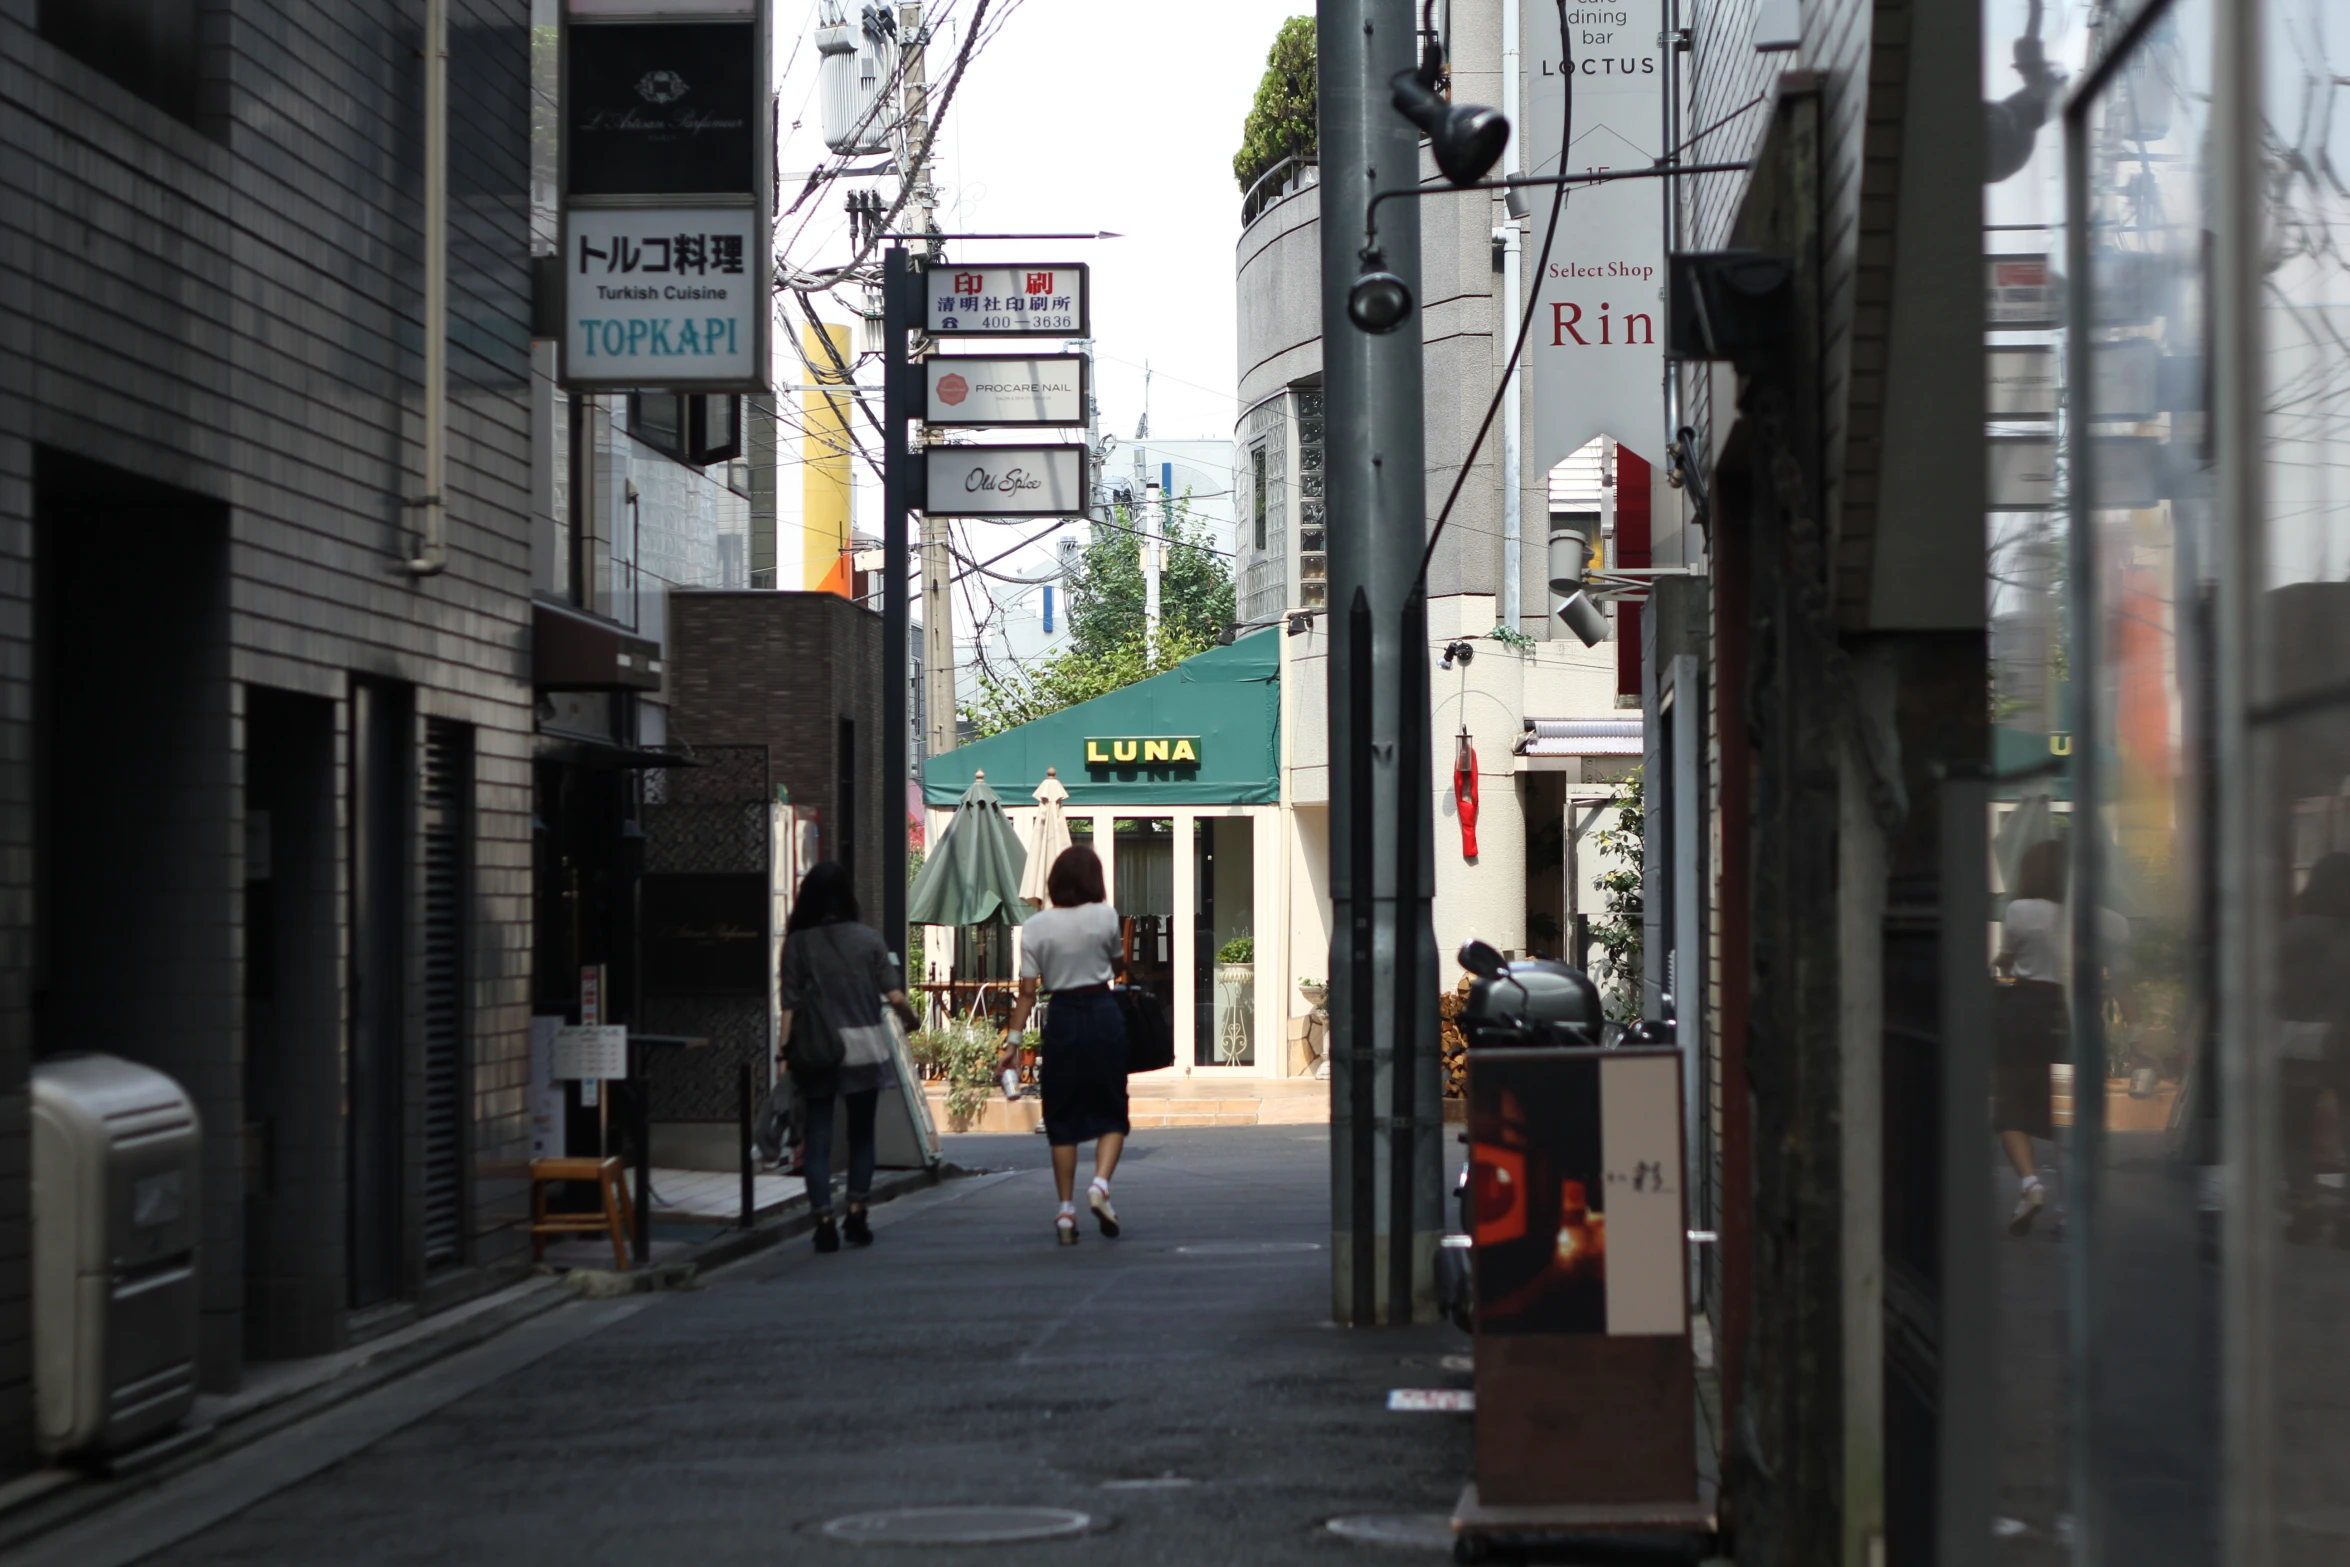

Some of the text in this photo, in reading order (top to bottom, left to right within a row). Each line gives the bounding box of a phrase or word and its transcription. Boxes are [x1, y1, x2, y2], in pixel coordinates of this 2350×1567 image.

[1568, 9, 1627, 26] dining
[1582, 30, 1614, 45] bar
[1542, 57, 1654, 76] LOCTUS
[579, 233, 745, 276] トルコ料理
[1549, 260, 1654, 281] Select Shop
[596, 285, 728, 300] Turkish Cuisine
[937, 296, 1072, 313] 清明社印刷所
[1548, 302, 1656, 347] Rin
[578, 317, 739, 357] TOPKAPI
[975, 384, 1039, 393] PROCARE
[1042, 383, 1073, 392] NAIL
[964, 467, 1042, 498] Old Spice
[1087, 740, 1196, 762] LUNA
